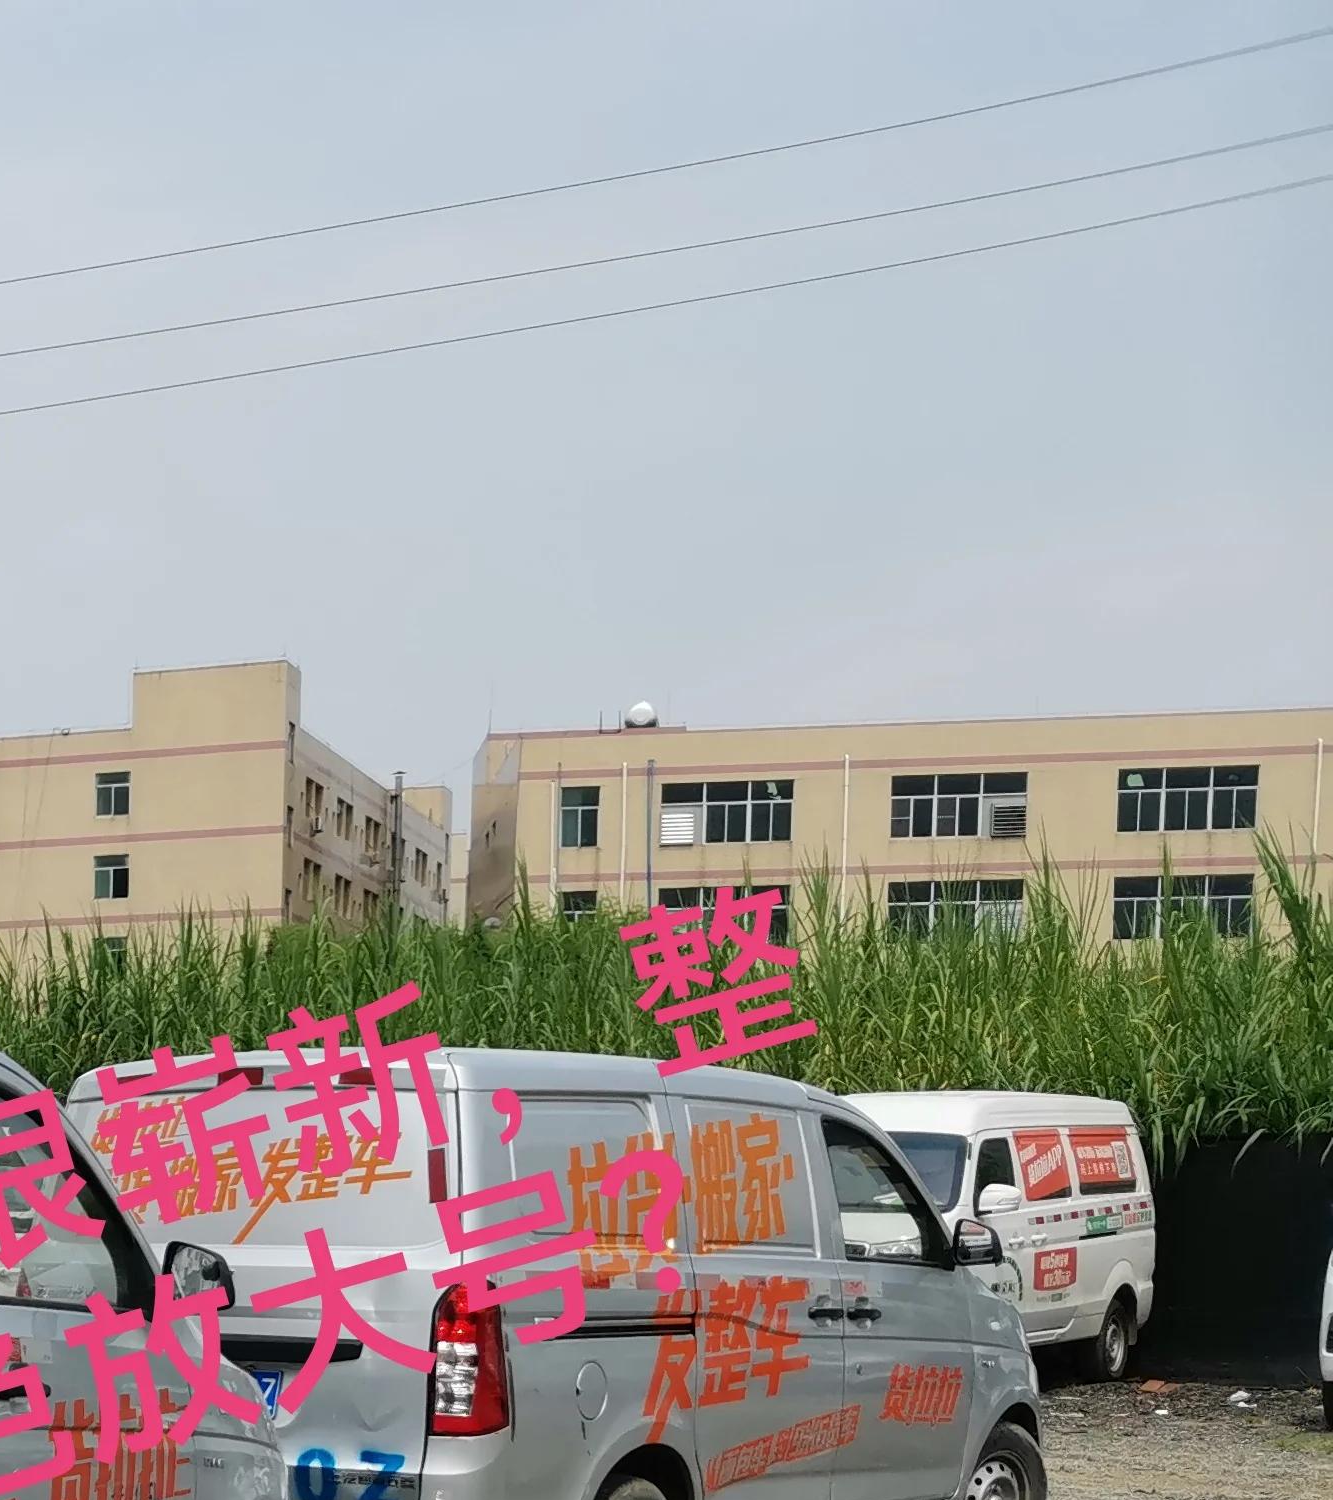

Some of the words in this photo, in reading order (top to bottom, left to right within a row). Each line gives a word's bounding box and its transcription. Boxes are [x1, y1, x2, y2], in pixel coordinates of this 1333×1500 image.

[643, 1276, 811, 1443] 发整车
[879, 1363, 963, 1427] 货拉拉
